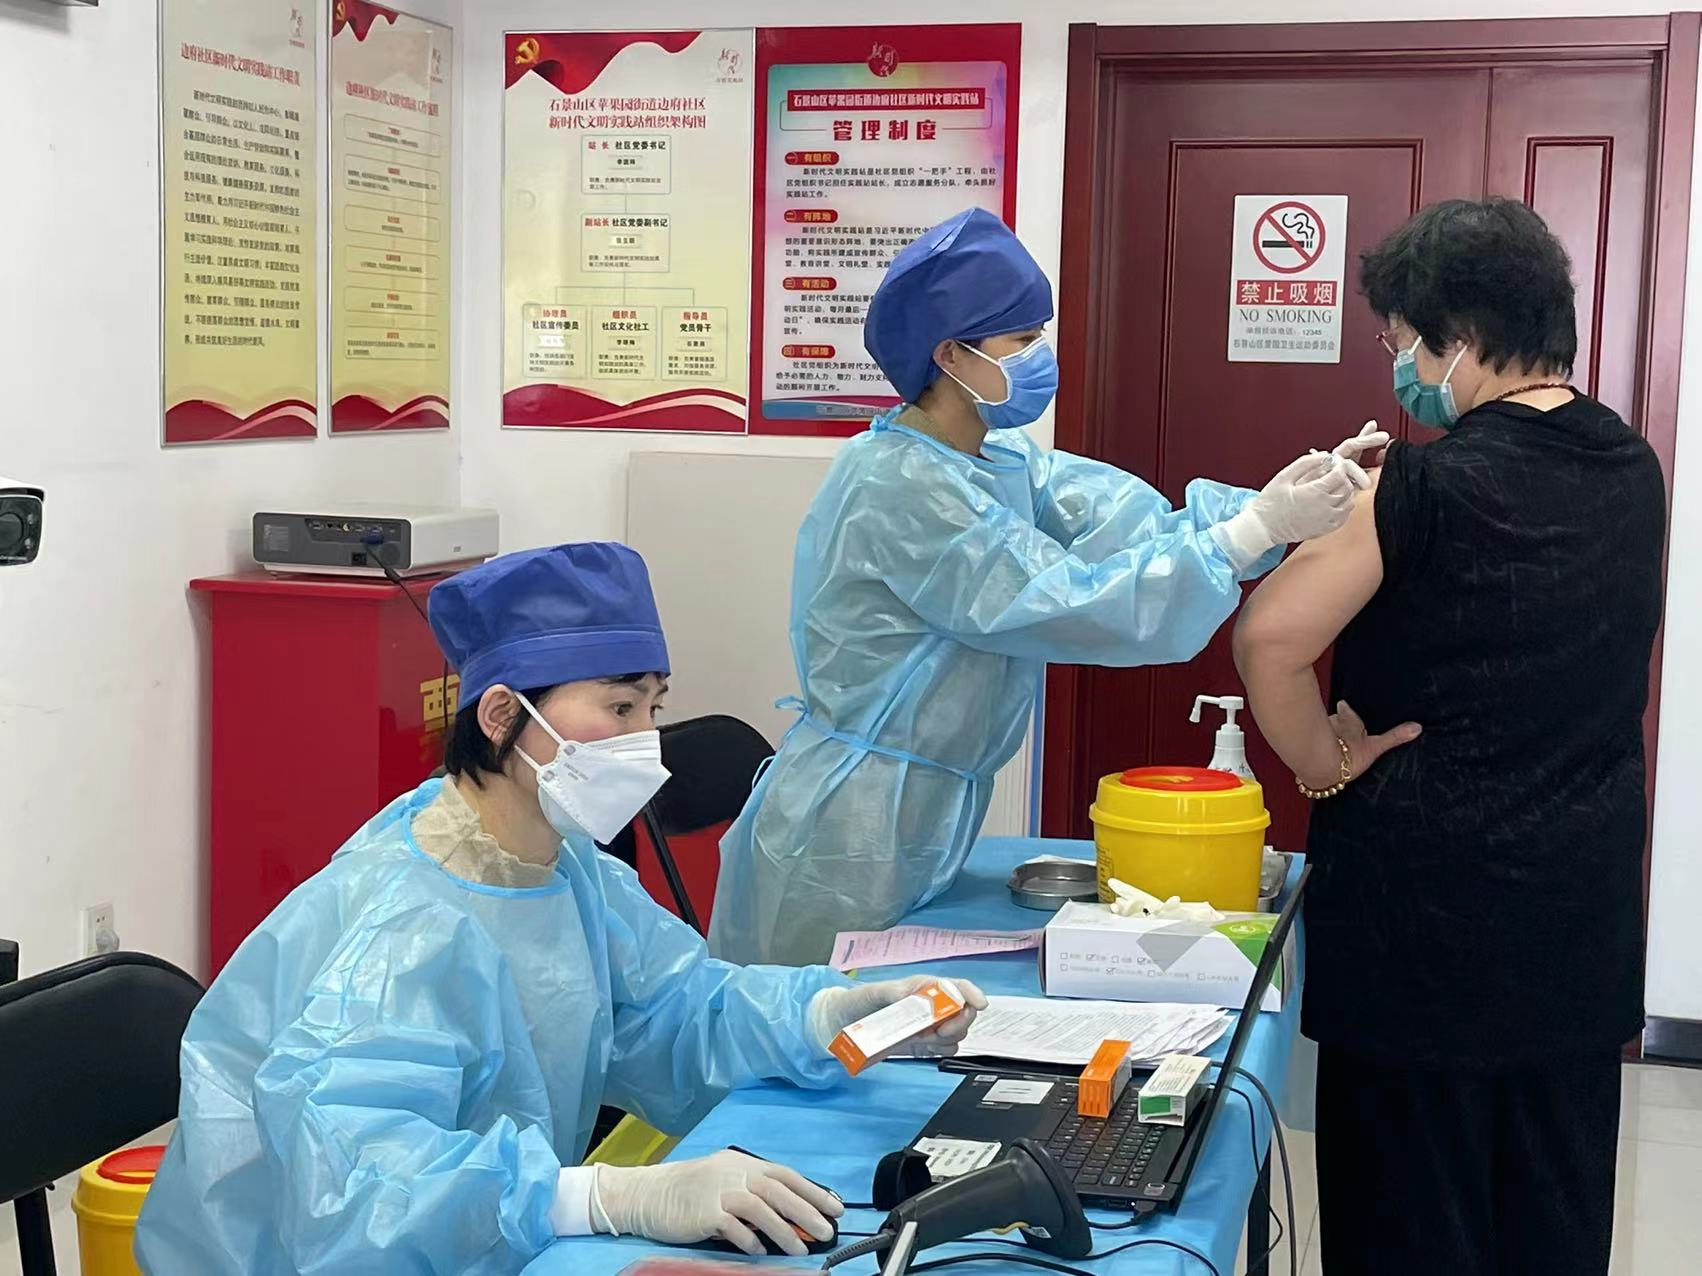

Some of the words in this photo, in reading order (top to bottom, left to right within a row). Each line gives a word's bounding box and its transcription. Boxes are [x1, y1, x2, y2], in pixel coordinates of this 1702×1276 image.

[549, 97, 706, 112] 石景山区苹果园街道边府社区
[549, 114, 706, 129] 新时代文明实践站组织架构图
[833, 120, 937, 141] 管理制度
[615, 141, 666, 150] 社区党委书记
[803, 153, 832, 163] 有组织
[612, 218, 668, 227] 社区党委副书记
[1240, 281, 1333, 304] 禁止吸烟
[1240, 309, 1260, 322] NO
[1267, 309, 1332, 323] SMOKING
[680, 323, 712, 332] 党员骨干
